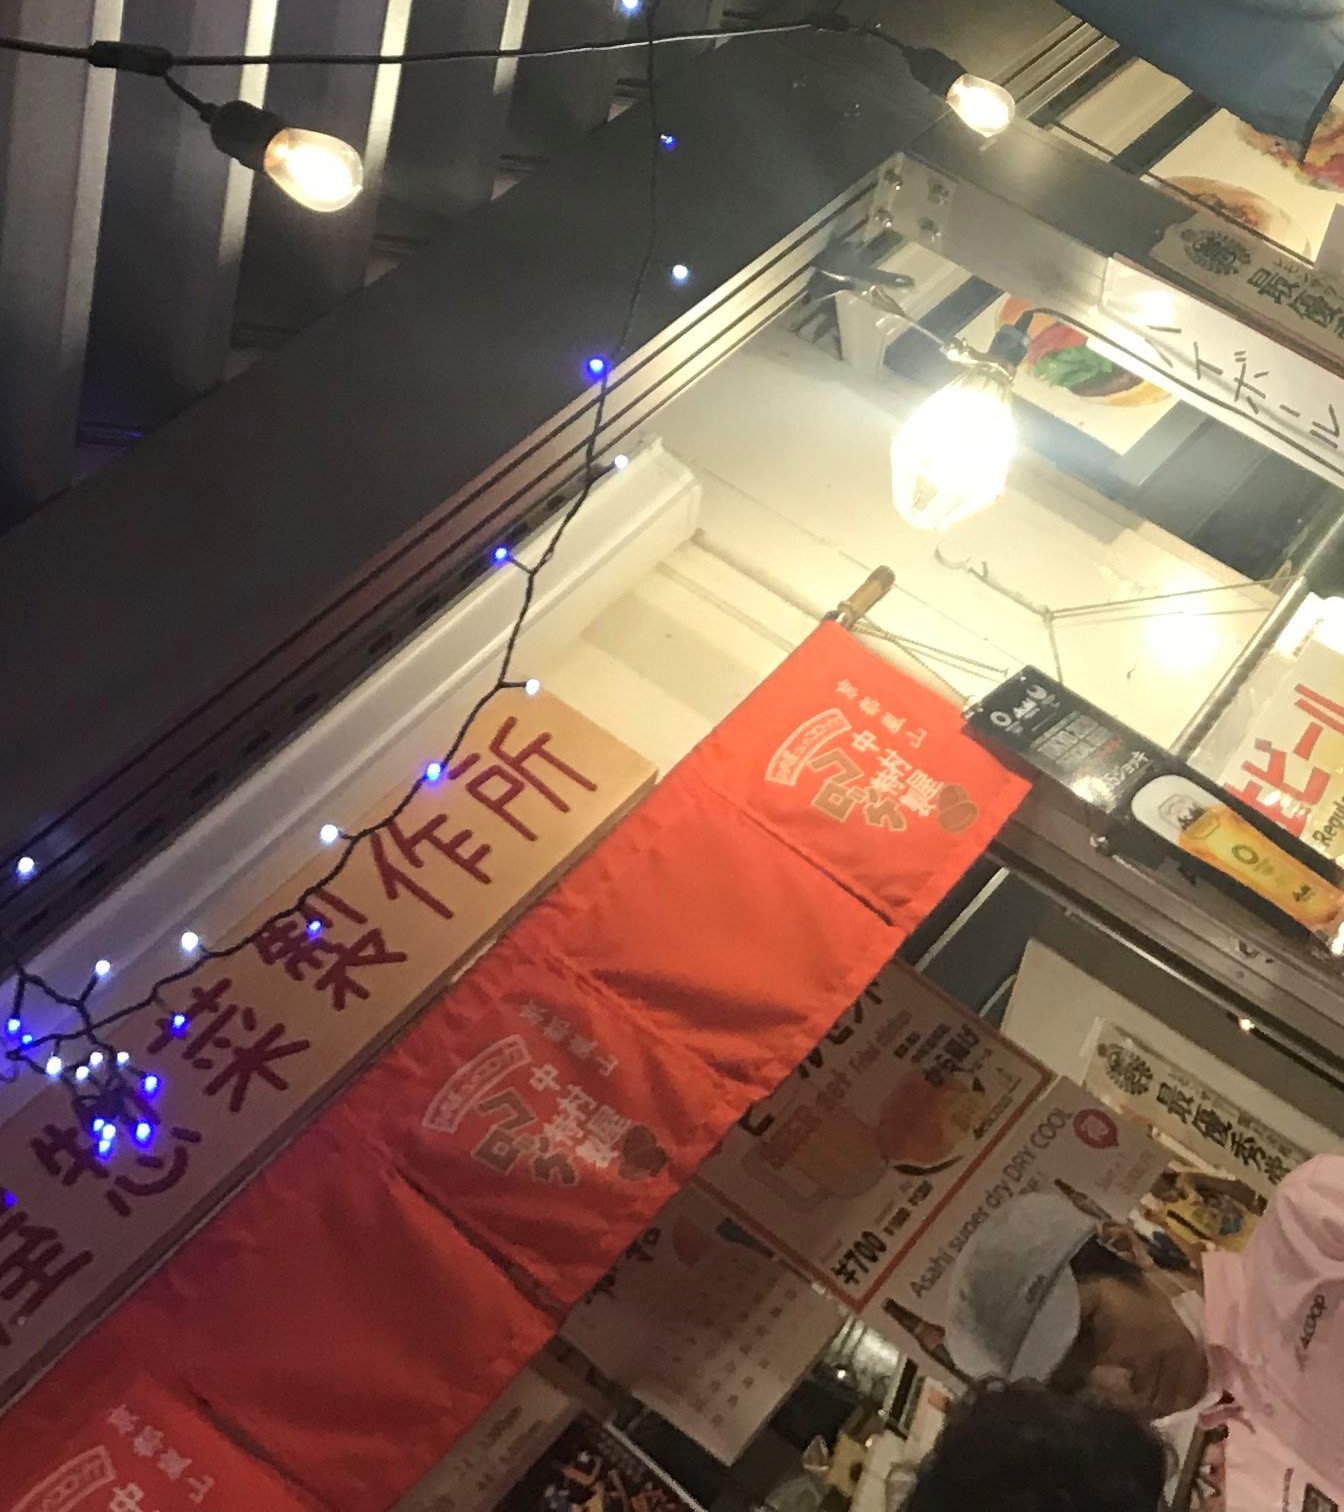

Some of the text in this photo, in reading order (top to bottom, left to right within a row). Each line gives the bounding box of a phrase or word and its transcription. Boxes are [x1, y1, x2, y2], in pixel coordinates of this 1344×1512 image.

[851, 730, 944, 800] 中村屋
[909, 1254, 955, 1299] Asahi
[986, 1179, 1014, 1212] dry
[1003, 1143, 1036, 1185] DRY
[1030, 1107, 1074, 1152] COOL
